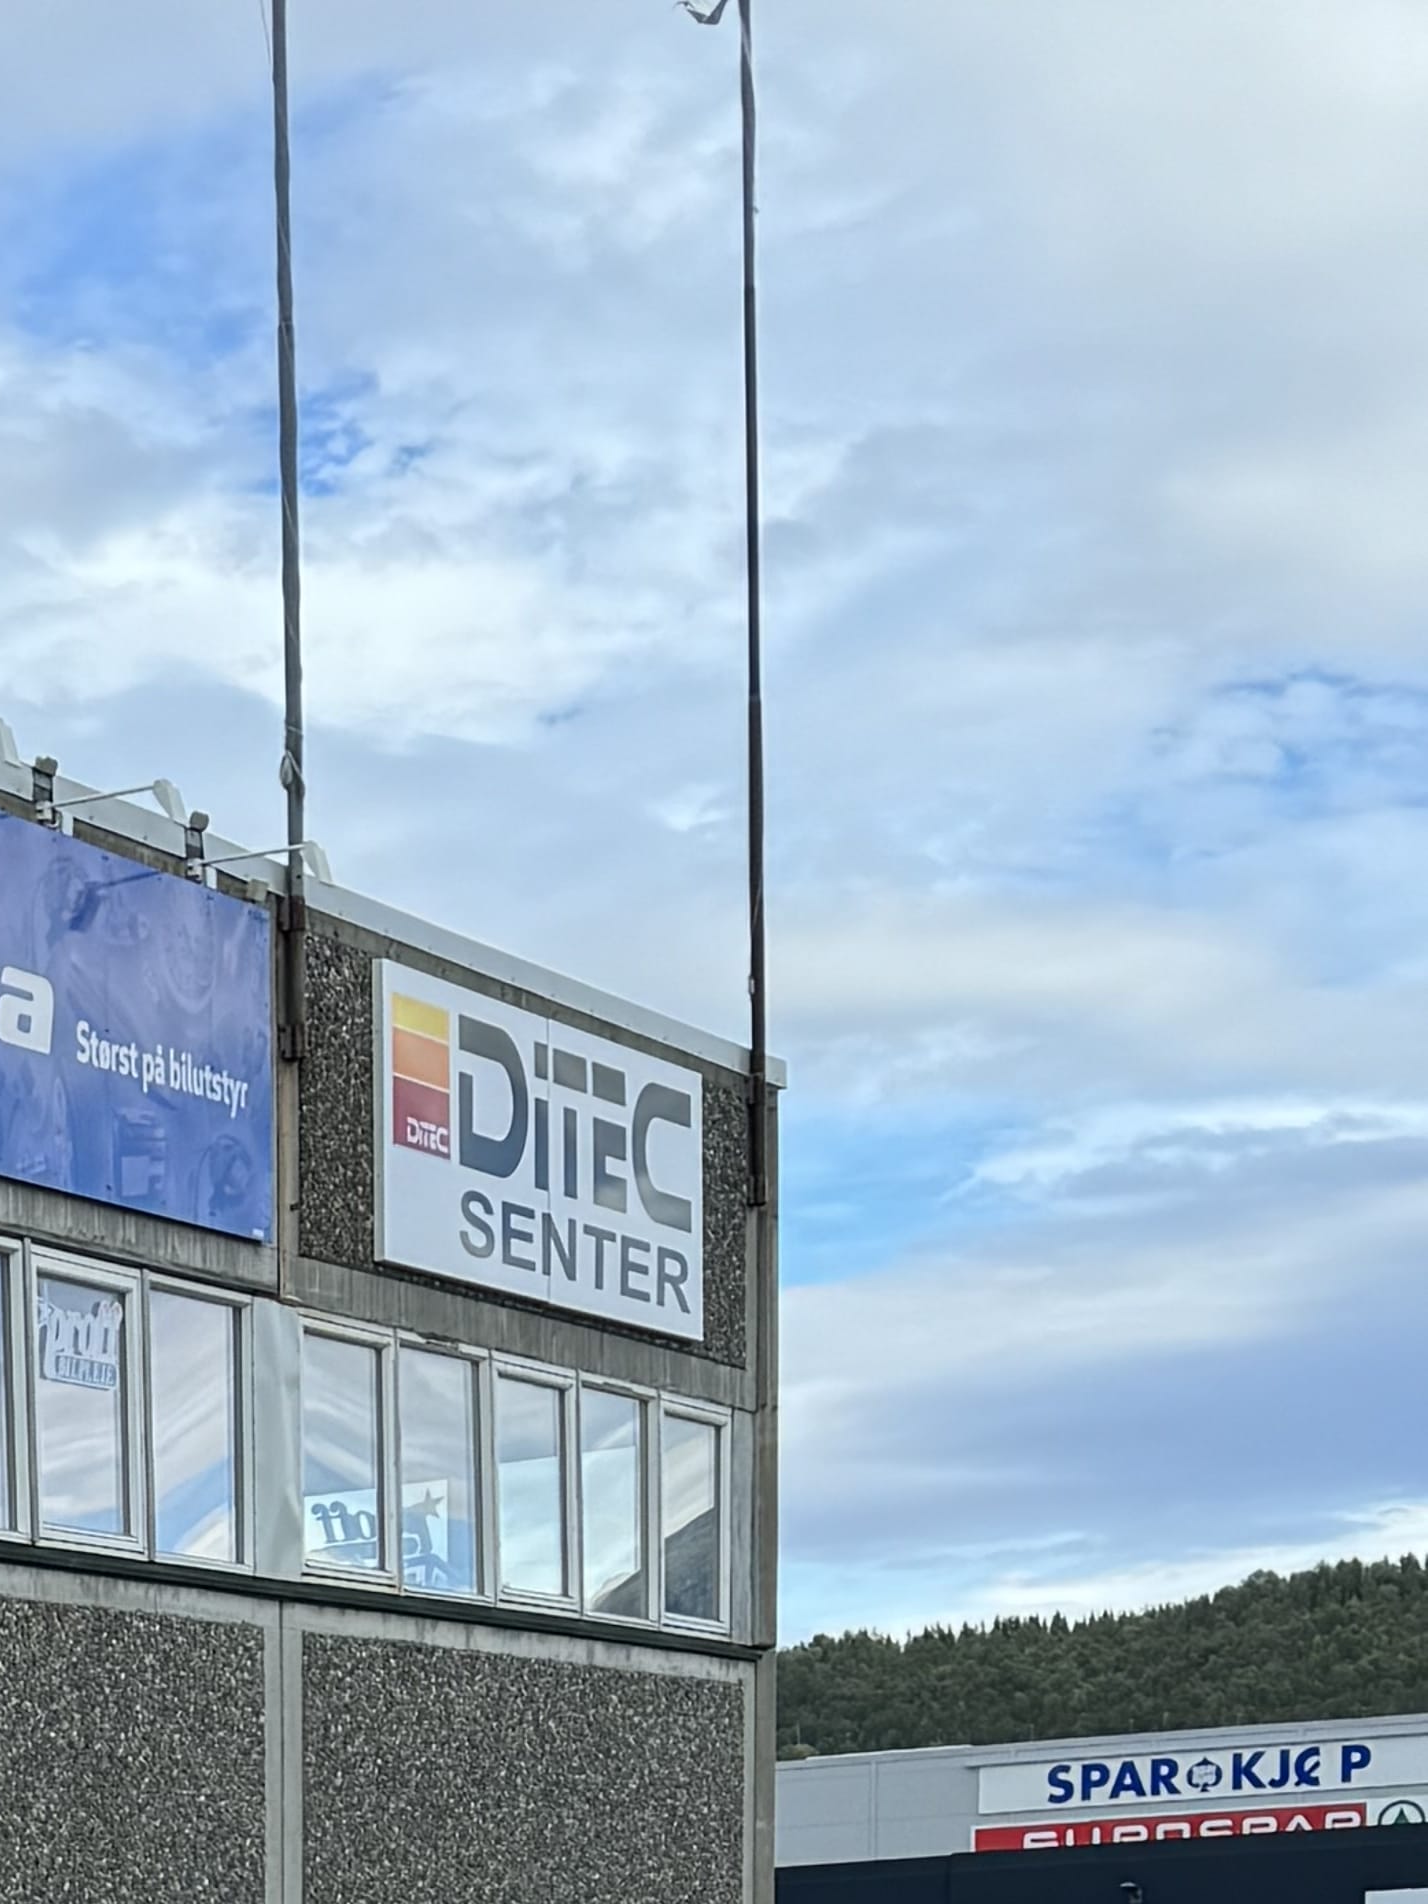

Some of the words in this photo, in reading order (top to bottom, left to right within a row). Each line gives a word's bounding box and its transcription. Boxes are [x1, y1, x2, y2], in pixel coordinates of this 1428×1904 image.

[75, 1020, 138, 1077] Størst
[142, 1044, 168, 1093] på
[169, 1051, 249, 1119] bilutstyr
[459, 1190, 691, 1315] SENTER
[1048, 1758, 1181, 1803] SPAR
